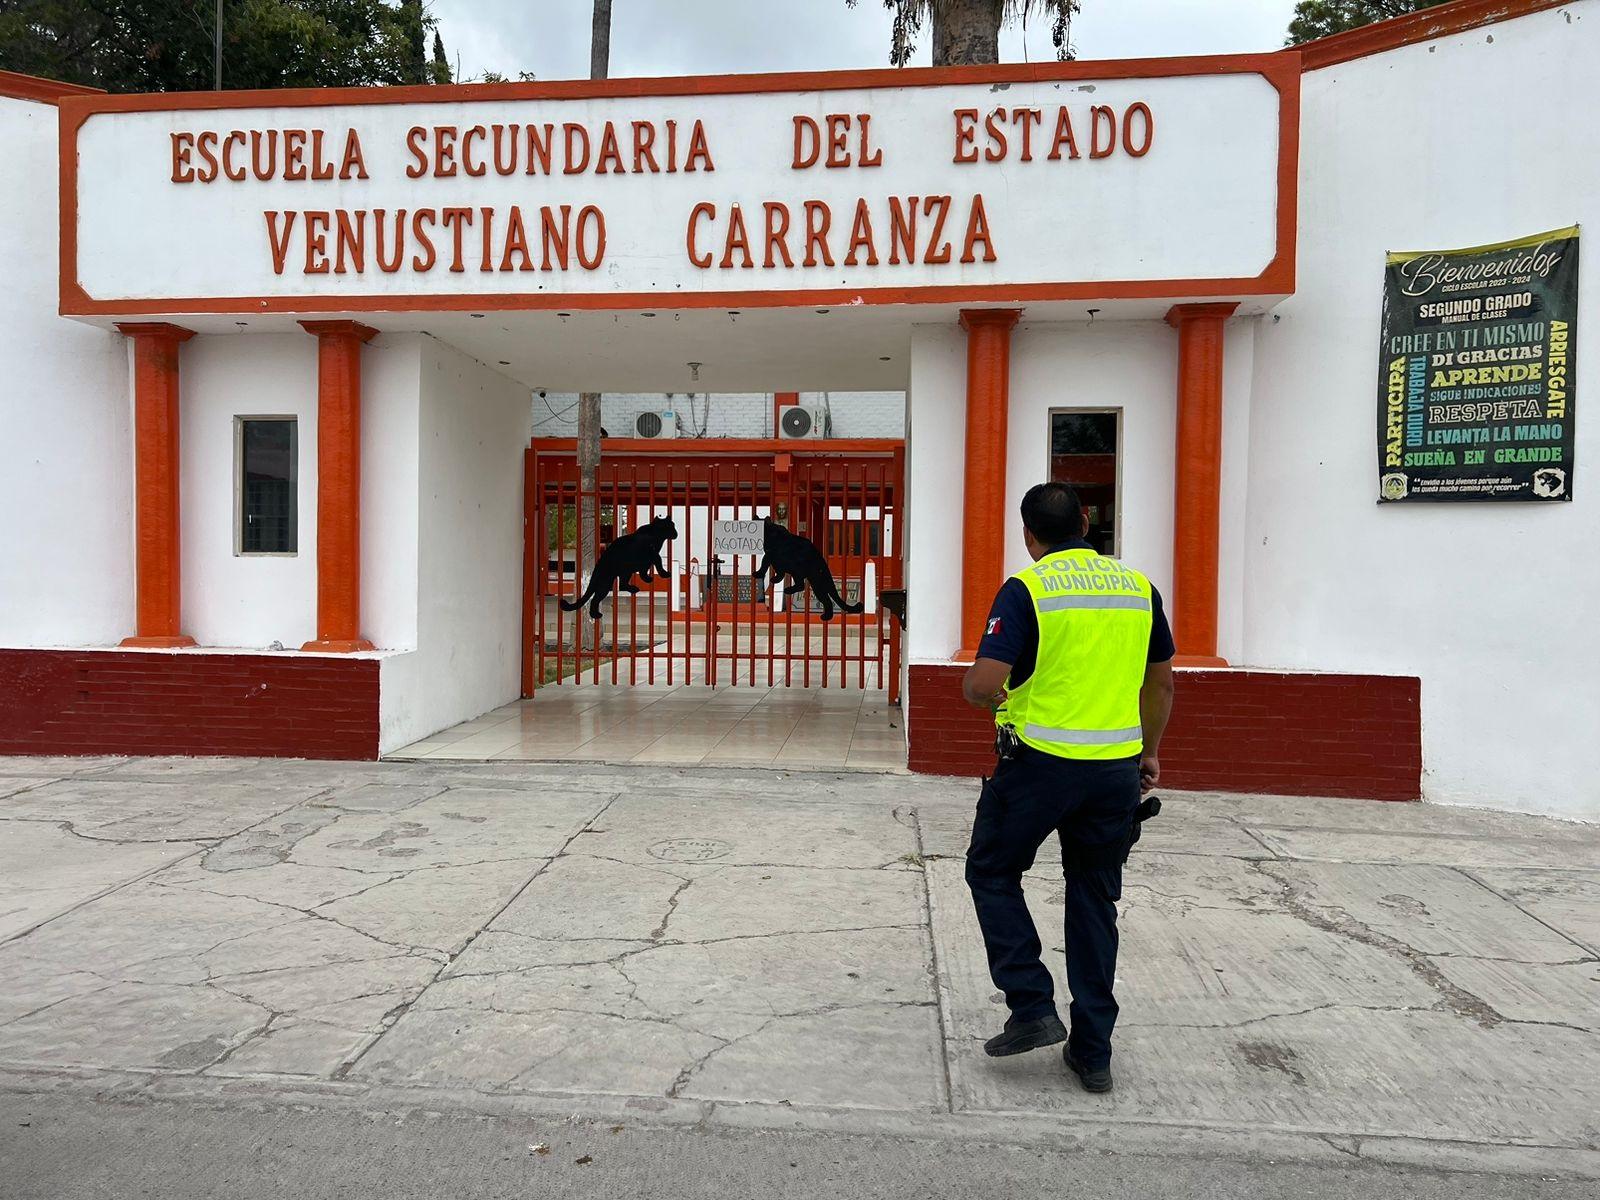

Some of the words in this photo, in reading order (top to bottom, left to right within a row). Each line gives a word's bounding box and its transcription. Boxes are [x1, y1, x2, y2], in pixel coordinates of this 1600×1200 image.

[171, 128, 367, 183] ESCUELA
[407, 120, 714, 178] SECUNDARIA
[793, 114, 883, 169] DEL
[954, 102, 1154, 164] ESTADO
[265, 204, 606, 275] VENUSTIANO
[687, 194, 997, 270] CARRANZA
[1401, 241, 1562, 296] Bienvenidos
[1441, 285, 1460, 293] CICLO
[1460, 280, 1488, 291] ESCOLAR
[1488, 278, 1507, 288] 2023
[1512, 275, 1531, 285] 2024
[1420, 298, 1481, 319] SEGUNDO
[1485, 292, 1532, 309] GRADO
[1441, 314, 1470, 324] MANUAL
[1471, 312, 1480, 321] DE
[1481, 310, 1507, 320] CLASES
[1391, 332, 1432, 354] CREE
[1436, 327, 1457, 350] EN
[1461, 328, 1478, 349] TI
[1483, 322, 1545, 346] MISMO
[1431, 353, 1454, 367] DI
[1457, 344, 1543, 364] GRACIAS
[1430, 363, 1543, 388] APRENDE
[1546, 320, 1568, 419] ARRIESGATE
[1408, 355, 1427, 412] TRABAJA
[1430, 388, 1461, 402] SIGUE
[1463, 383, 1542, 400] INDICACIONES
[1386, 355, 1406, 467] PARTICIPA
[1429, 400, 1543, 424] RESPETA
[1406, 413, 1424, 447] DURO
[1427, 428, 1490, 445] LEVANTA
[1493, 427, 1511, 442] LA
[1514, 424, 1563, 441] MANO
[1404, 448, 1456, 467] SUEÑA
[1463, 450, 1486, 465] EN
[1494, 447, 1563, 463] GRANDE
[724, 520, 757, 534] CUPO
[715, 537, 764, 551] AGOTADO
[1032, 557, 1136, 577] POLICIA
[1040, 574, 1142, 592] MUNICIPAL
